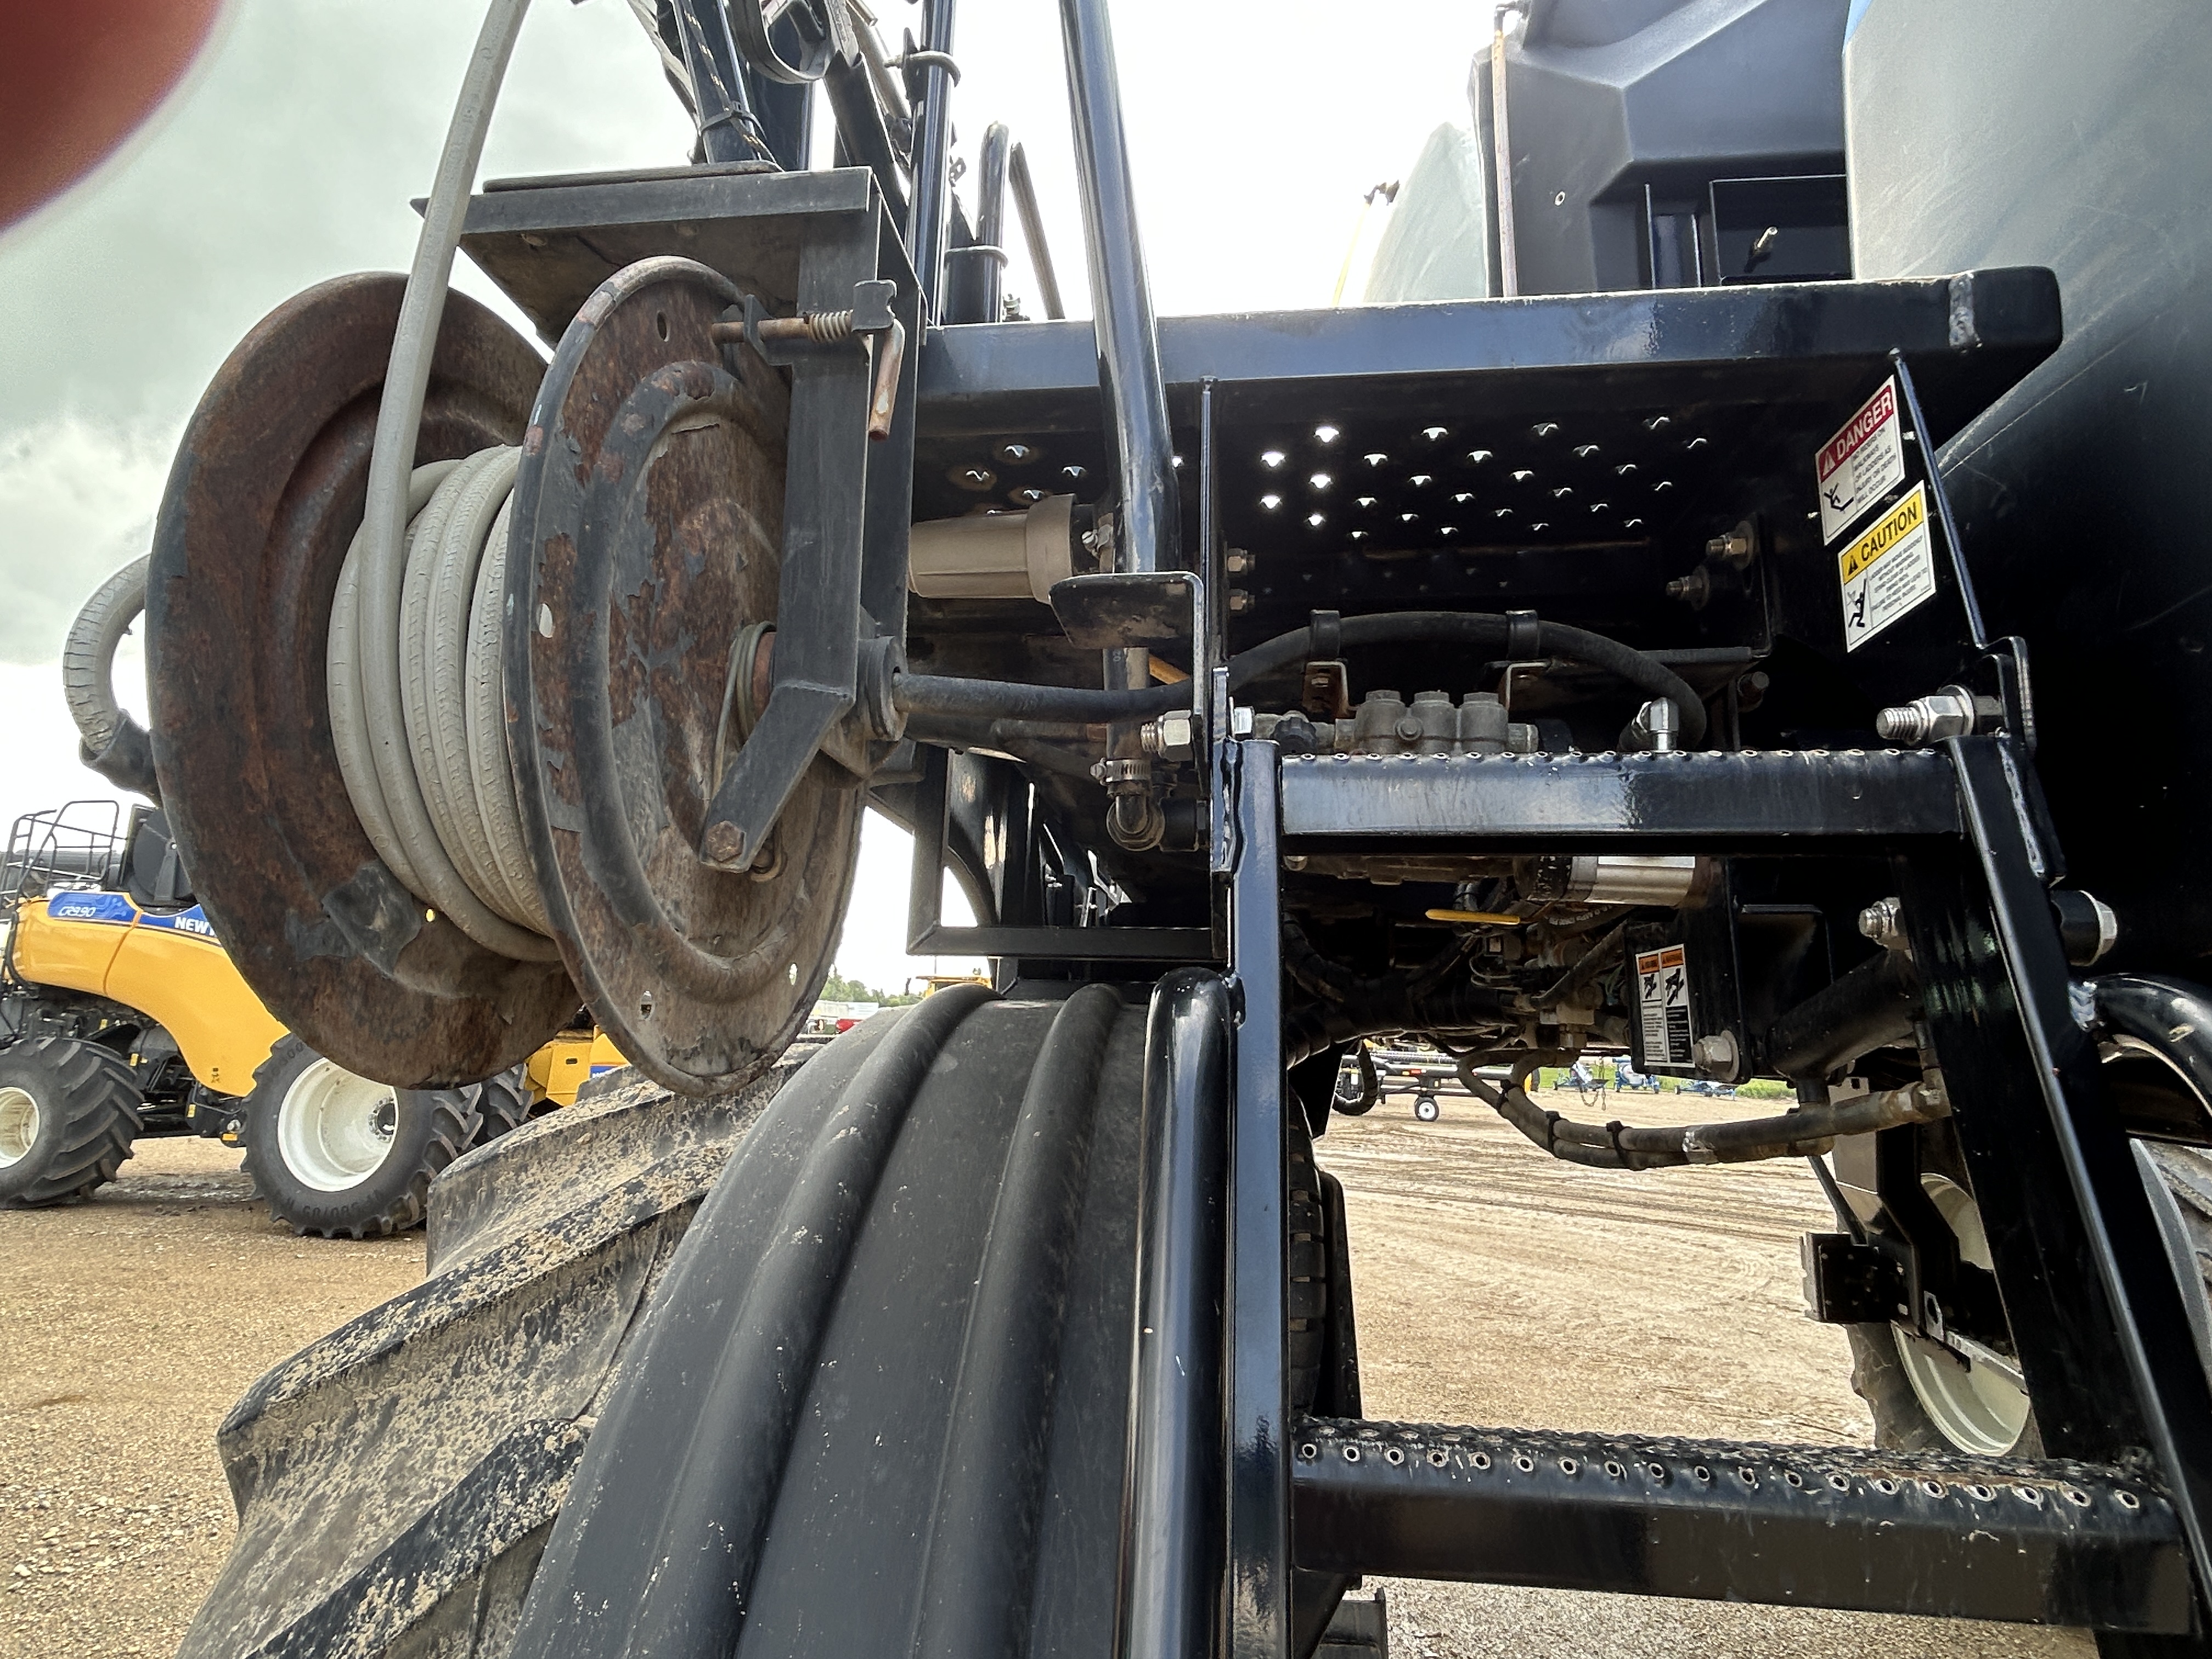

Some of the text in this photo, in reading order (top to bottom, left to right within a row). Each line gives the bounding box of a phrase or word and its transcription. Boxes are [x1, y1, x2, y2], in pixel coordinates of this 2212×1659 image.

[1836, 391, 1892, 461] DANGER
[1861, 501, 1917, 561] CAUTION
[174, 916, 210, 934] NEW
